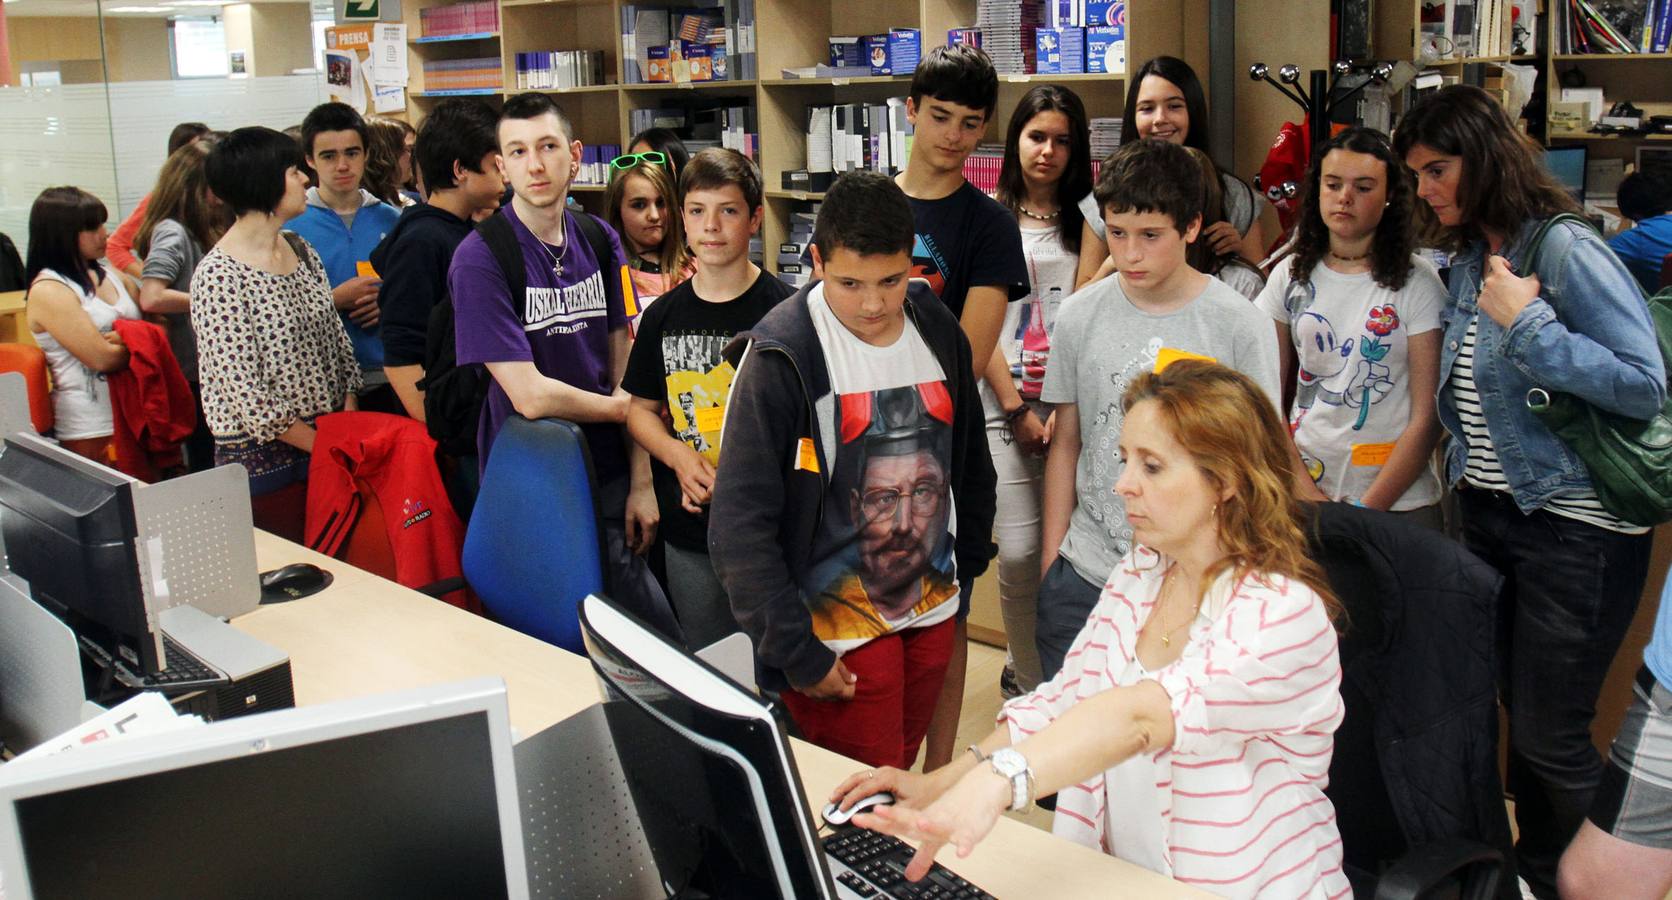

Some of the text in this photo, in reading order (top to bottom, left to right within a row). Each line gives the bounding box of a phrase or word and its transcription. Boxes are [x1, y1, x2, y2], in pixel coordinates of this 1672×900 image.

[339, 31, 369, 46] PRENSA
[525, 270, 607, 324] USKAL HERRIA
